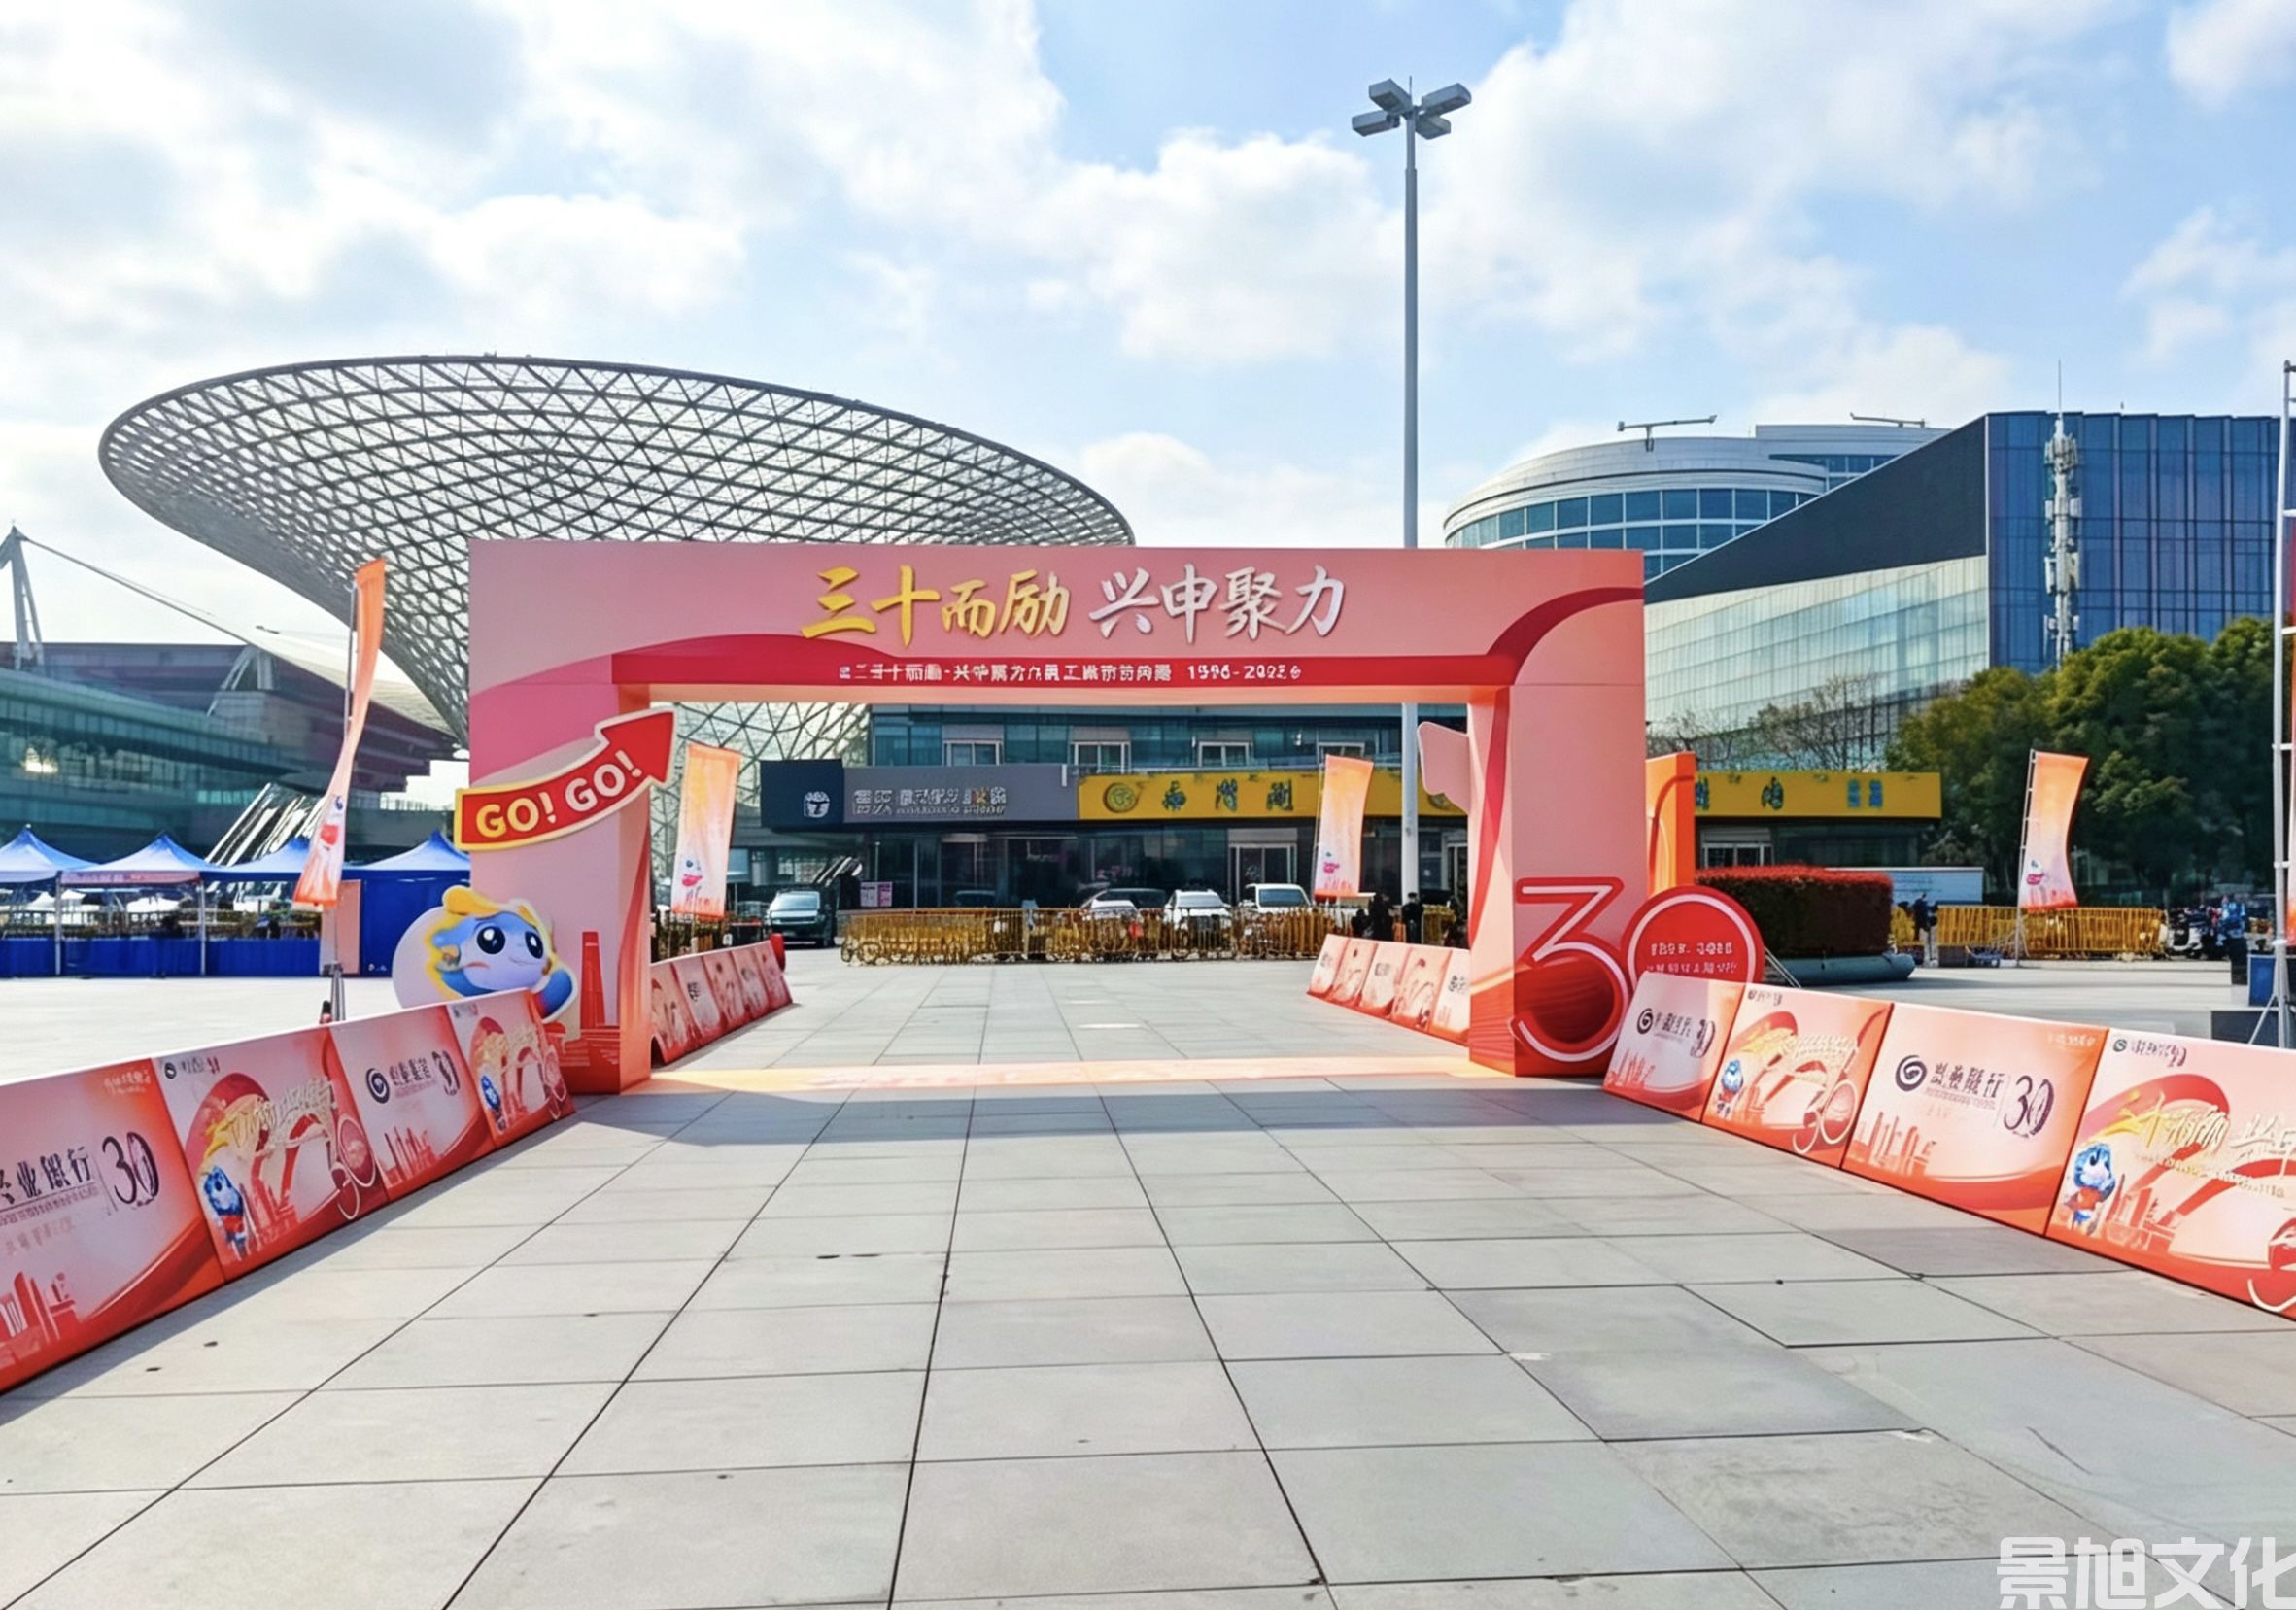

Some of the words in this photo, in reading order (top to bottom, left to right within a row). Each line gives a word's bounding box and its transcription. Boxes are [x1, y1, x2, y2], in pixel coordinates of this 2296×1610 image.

[801, 565, 1070, 648] 三十而励
[1088, 564, 1345, 645] 兴申聚力
[476, 792, 556, 838] GO!
[565, 750, 642, 812] GO!
[2004, 1075, 2055, 1138] 30
[102, 1132, 159, 1206] 30
